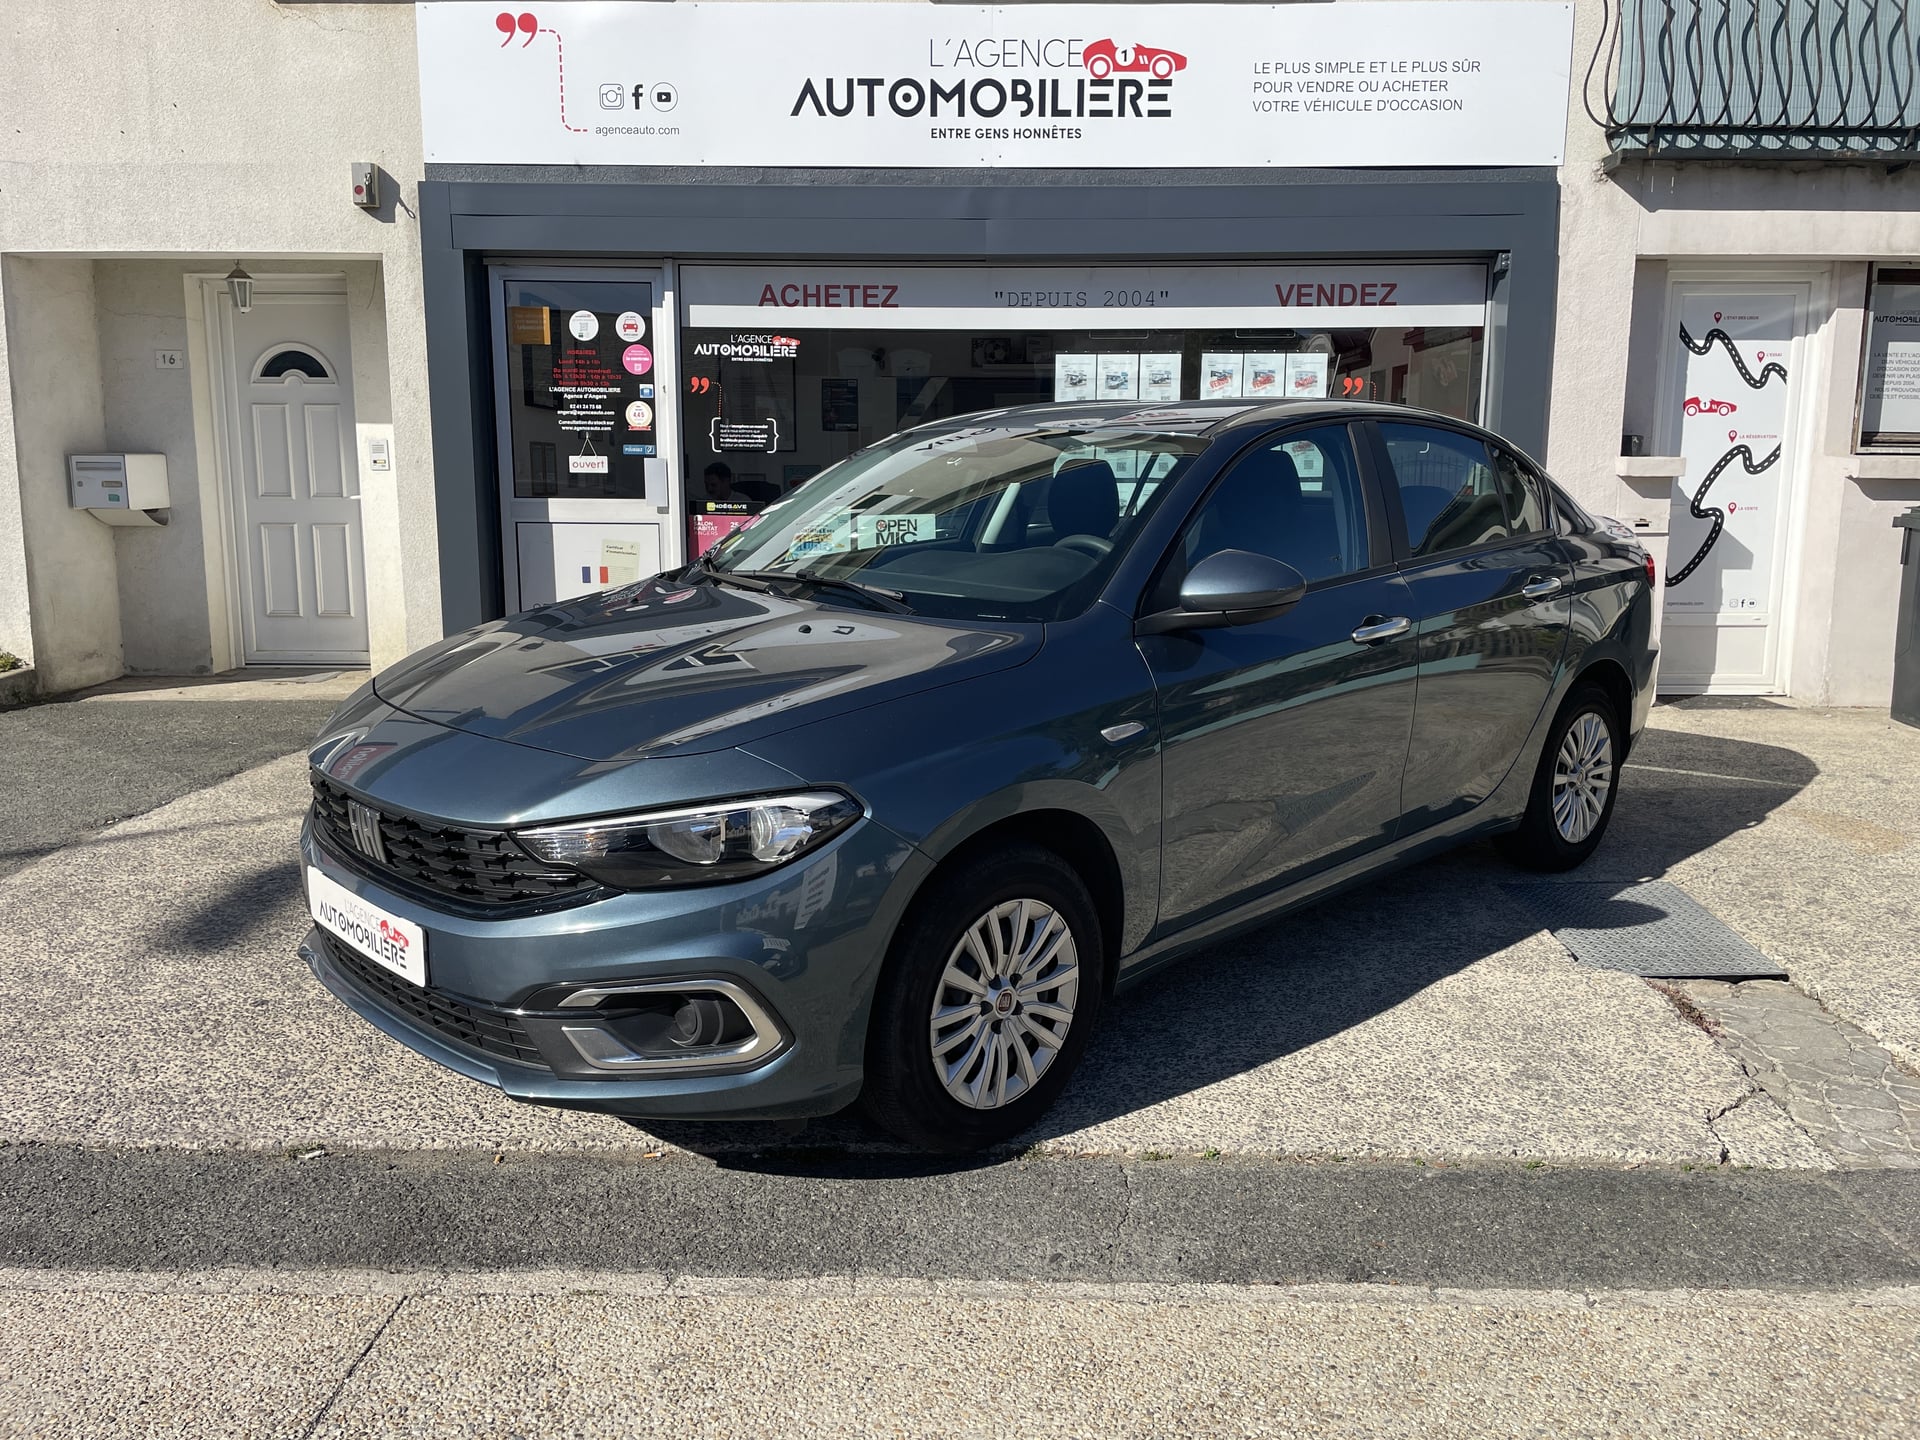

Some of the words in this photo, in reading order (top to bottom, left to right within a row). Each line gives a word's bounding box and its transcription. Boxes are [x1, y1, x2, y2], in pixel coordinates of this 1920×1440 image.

[929, 38, 1083, 68] L'AGENCE
[1254, 62, 1270, 74] LE
[1275, 62, 1310, 74] PLUS
[1314, 61, 1365, 74] SIMPLE
[1369, 61, 1387, 73] ET
[1391, 61, 1407, 73] LE
[1411, 61, 1448, 73] PLUS
[1452, 58, 1481, 73] SÛR
[1253, 81, 1293, 93] POUR
[1297, 81, 1354, 93] VENDRE
[1358, 80, 1378, 92] OU
[1382, 80, 1448, 92] ACHETER
[1252, 100, 1299, 112] VOTRE
[1303, 97, 1372, 112] VÉHICULE
[1377, 99, 1463, 112] D'OCCASION
[595, 124, 680, 137] agenceauto.com
[930, 127, 971, 140] ENTRE
[975, 127, 1009, 140] GENS
[1013, 124, 1082, 140] HONNÊTES
[758, 284, 900, 309] ACHETEZ
[994, 290, 1087, 308] "DEPUIS
[1103, 290, 1169, 307] 2004"
[1274, 283, 1398, 307] VENDEZ
[730, 334, 773, 344] L'AGENCE
[161, 354, 176, 365] 16
[572, 460, 605, 470] ouvert
[875, 519, 918, 533] OPEN
[875, 532, 918, 545] MIC
